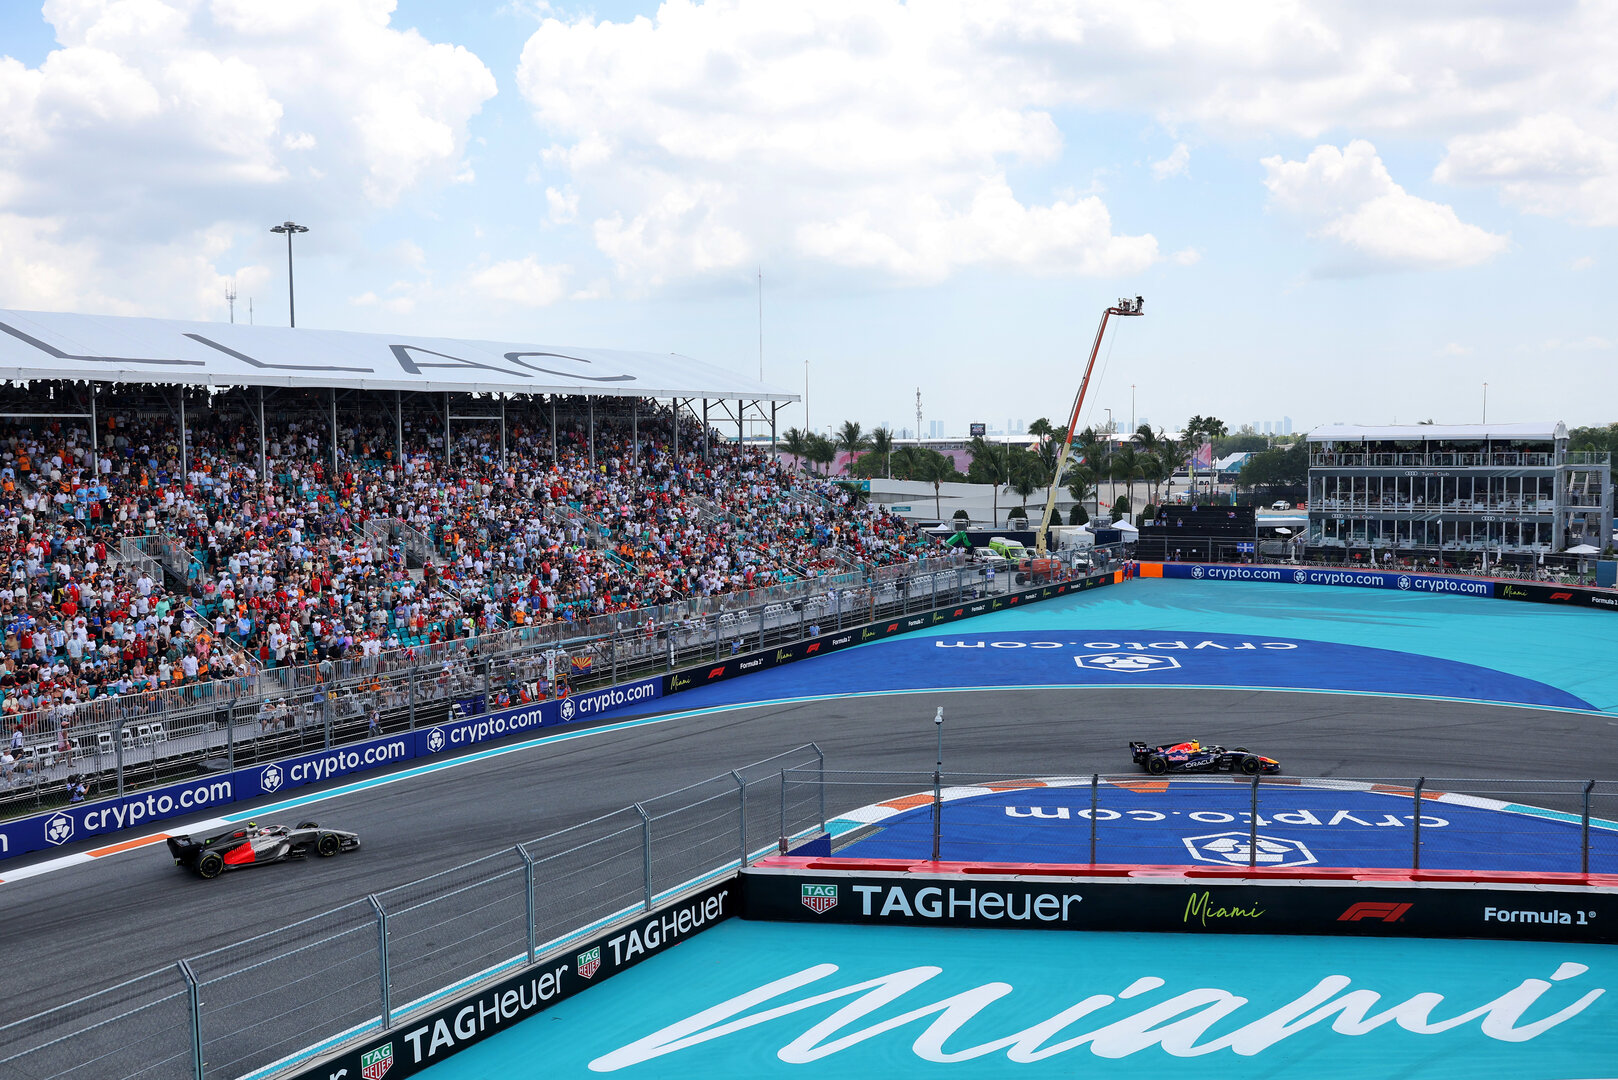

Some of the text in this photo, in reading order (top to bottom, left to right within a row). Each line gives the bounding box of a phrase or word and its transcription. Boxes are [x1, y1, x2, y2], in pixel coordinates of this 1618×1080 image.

[1208, 566, 1281, 581] crypto.com
[1310, 570, 1384, 587] crypto.com
[1414, 577, 1488, 595] crypto.com
[1503, 585, 1528, 598] Miami
[1592, 596, 1614, 605] Formula
[935, 640, 1298, 650] crypto.com
[740, 660, 758, 670] Formula
[776, 649, 794, 663] Miami
[670, 674, 691, 692] Miami
[579, 682, 654, 713] crypto.com
[450, 708, 542, 743] crypto.com
[290, 740, 405, 781] crypto.com
[1185, 757, 1214, 768] ORACLE
[84, 781, 232, 831] crypto.com
[1005, 806, 1450, 828] crypto.com
[805, 886, 834, 896] TAG
[804, 897, 836, 911] HEUER
[1183, 890, 1266, 927] Miami
[1484, 906, 1571, 925] Formula
[580, 950, 598, 965] TAG
[587, 961, 1606, 1073] Miami
[364, 1045, 390, 1065] TAG
[363, 1057, 392, 1079] HEUER
